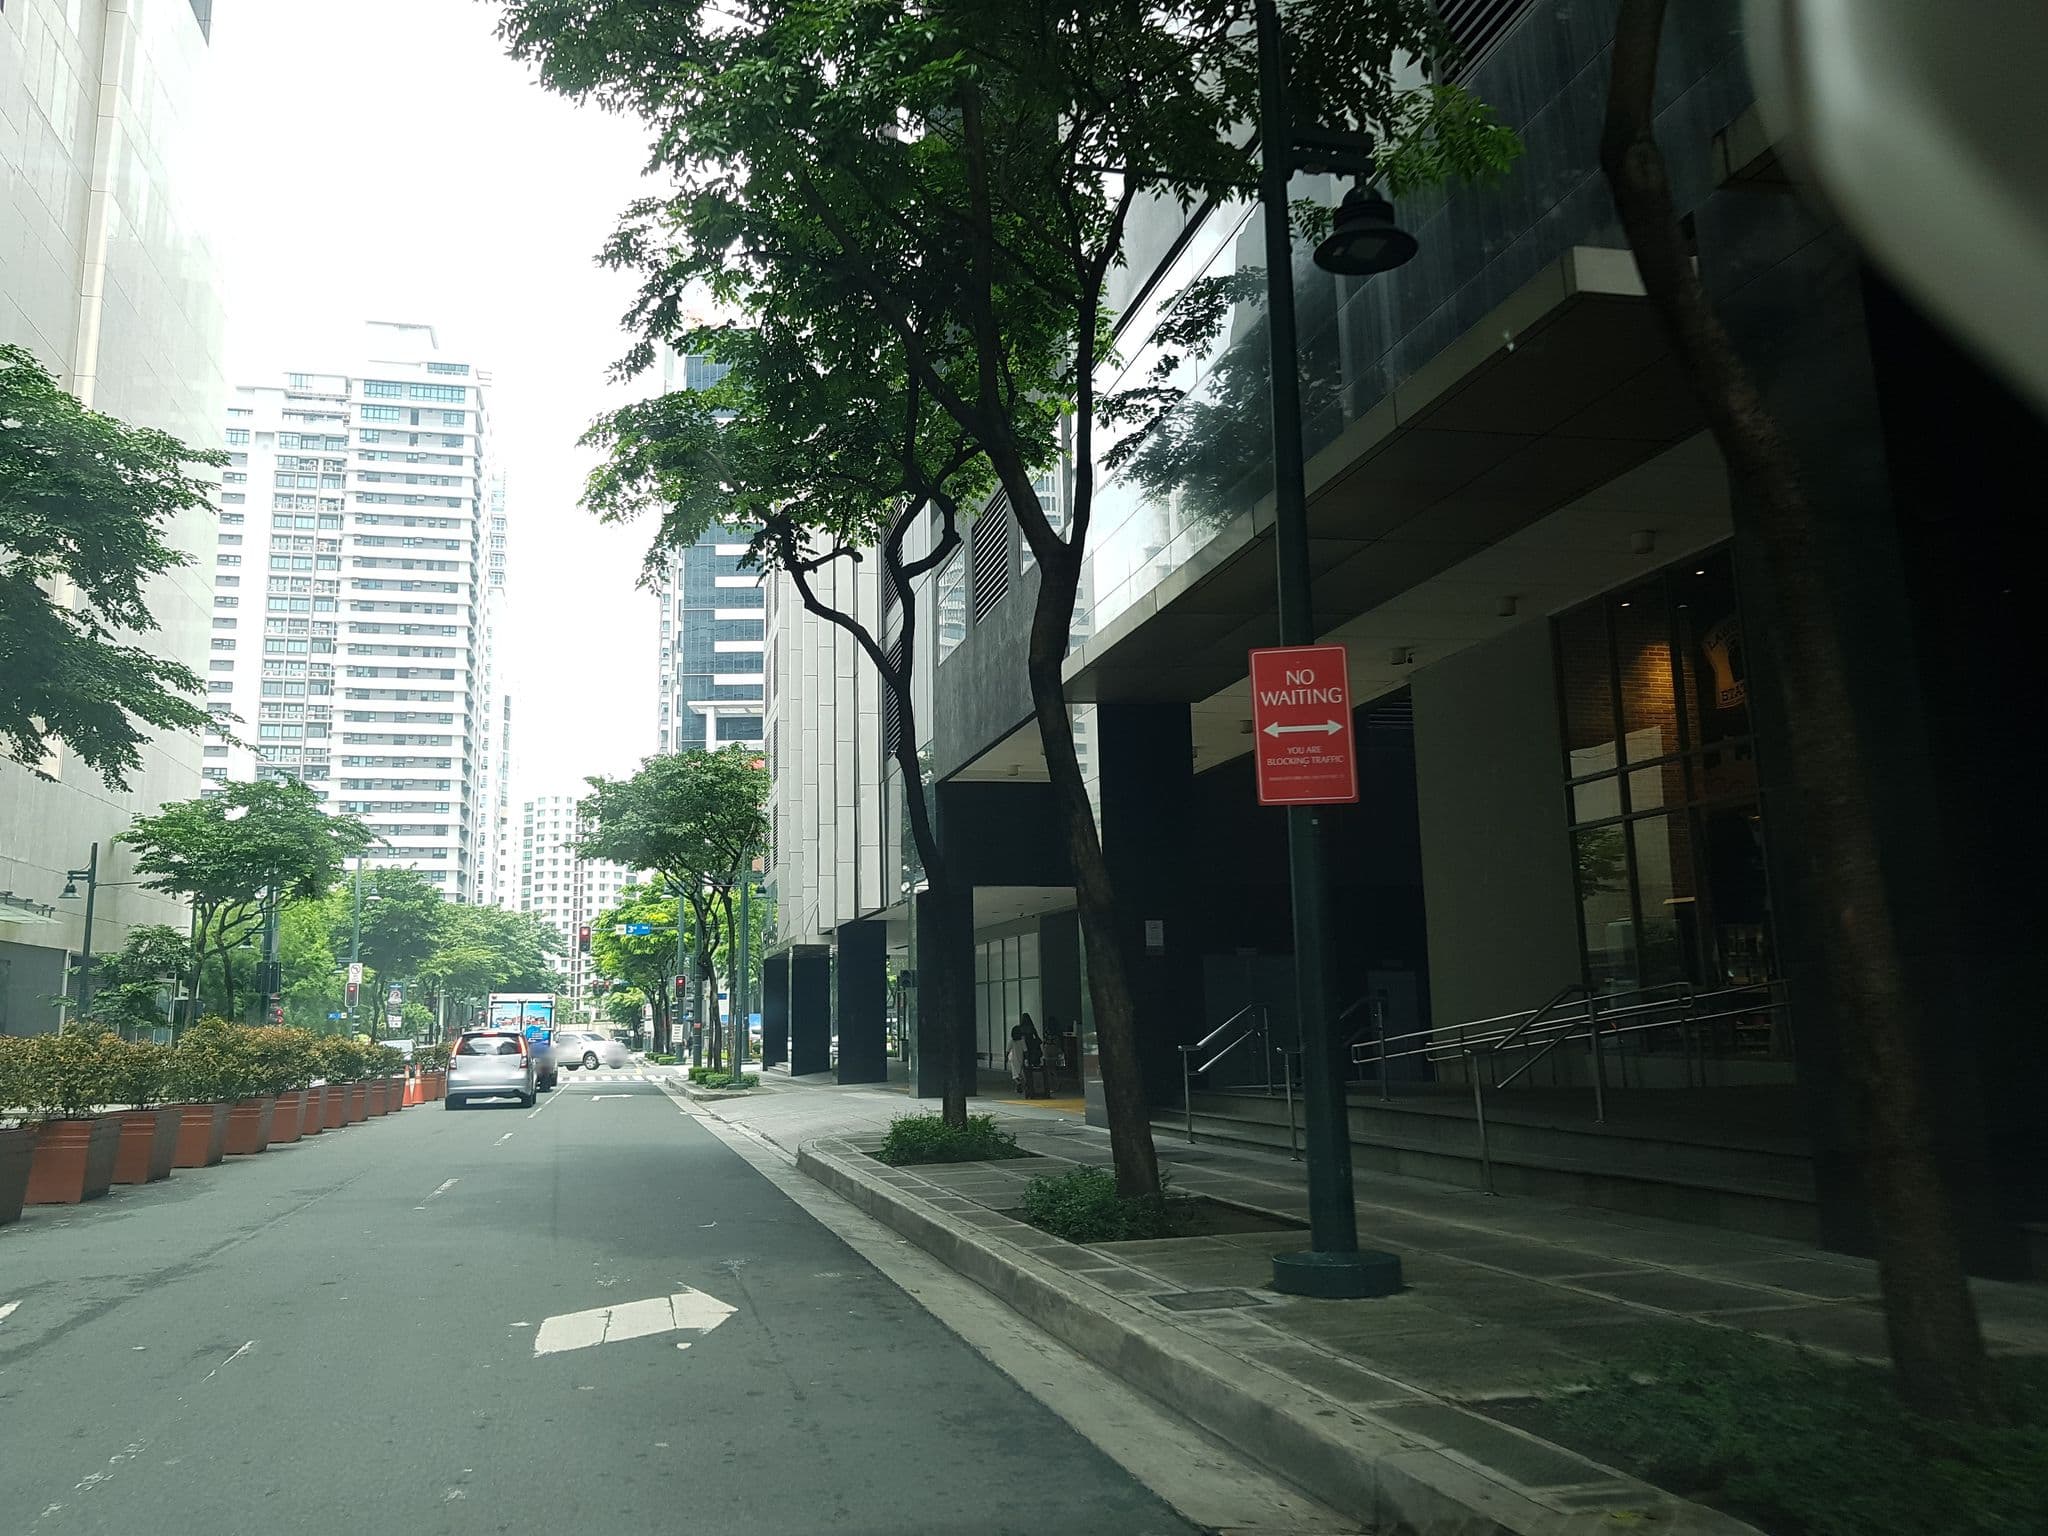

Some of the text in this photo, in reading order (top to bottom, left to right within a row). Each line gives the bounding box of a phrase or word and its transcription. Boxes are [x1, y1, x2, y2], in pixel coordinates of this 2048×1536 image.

[1286, 669, 1315, 685] NO
[1260, 687, 1343, 706] WAITING
[1287, 745, 1322, 754] YOU ARE
[1267, 755, 1344, 766] BLOCKING TRAFFIC
